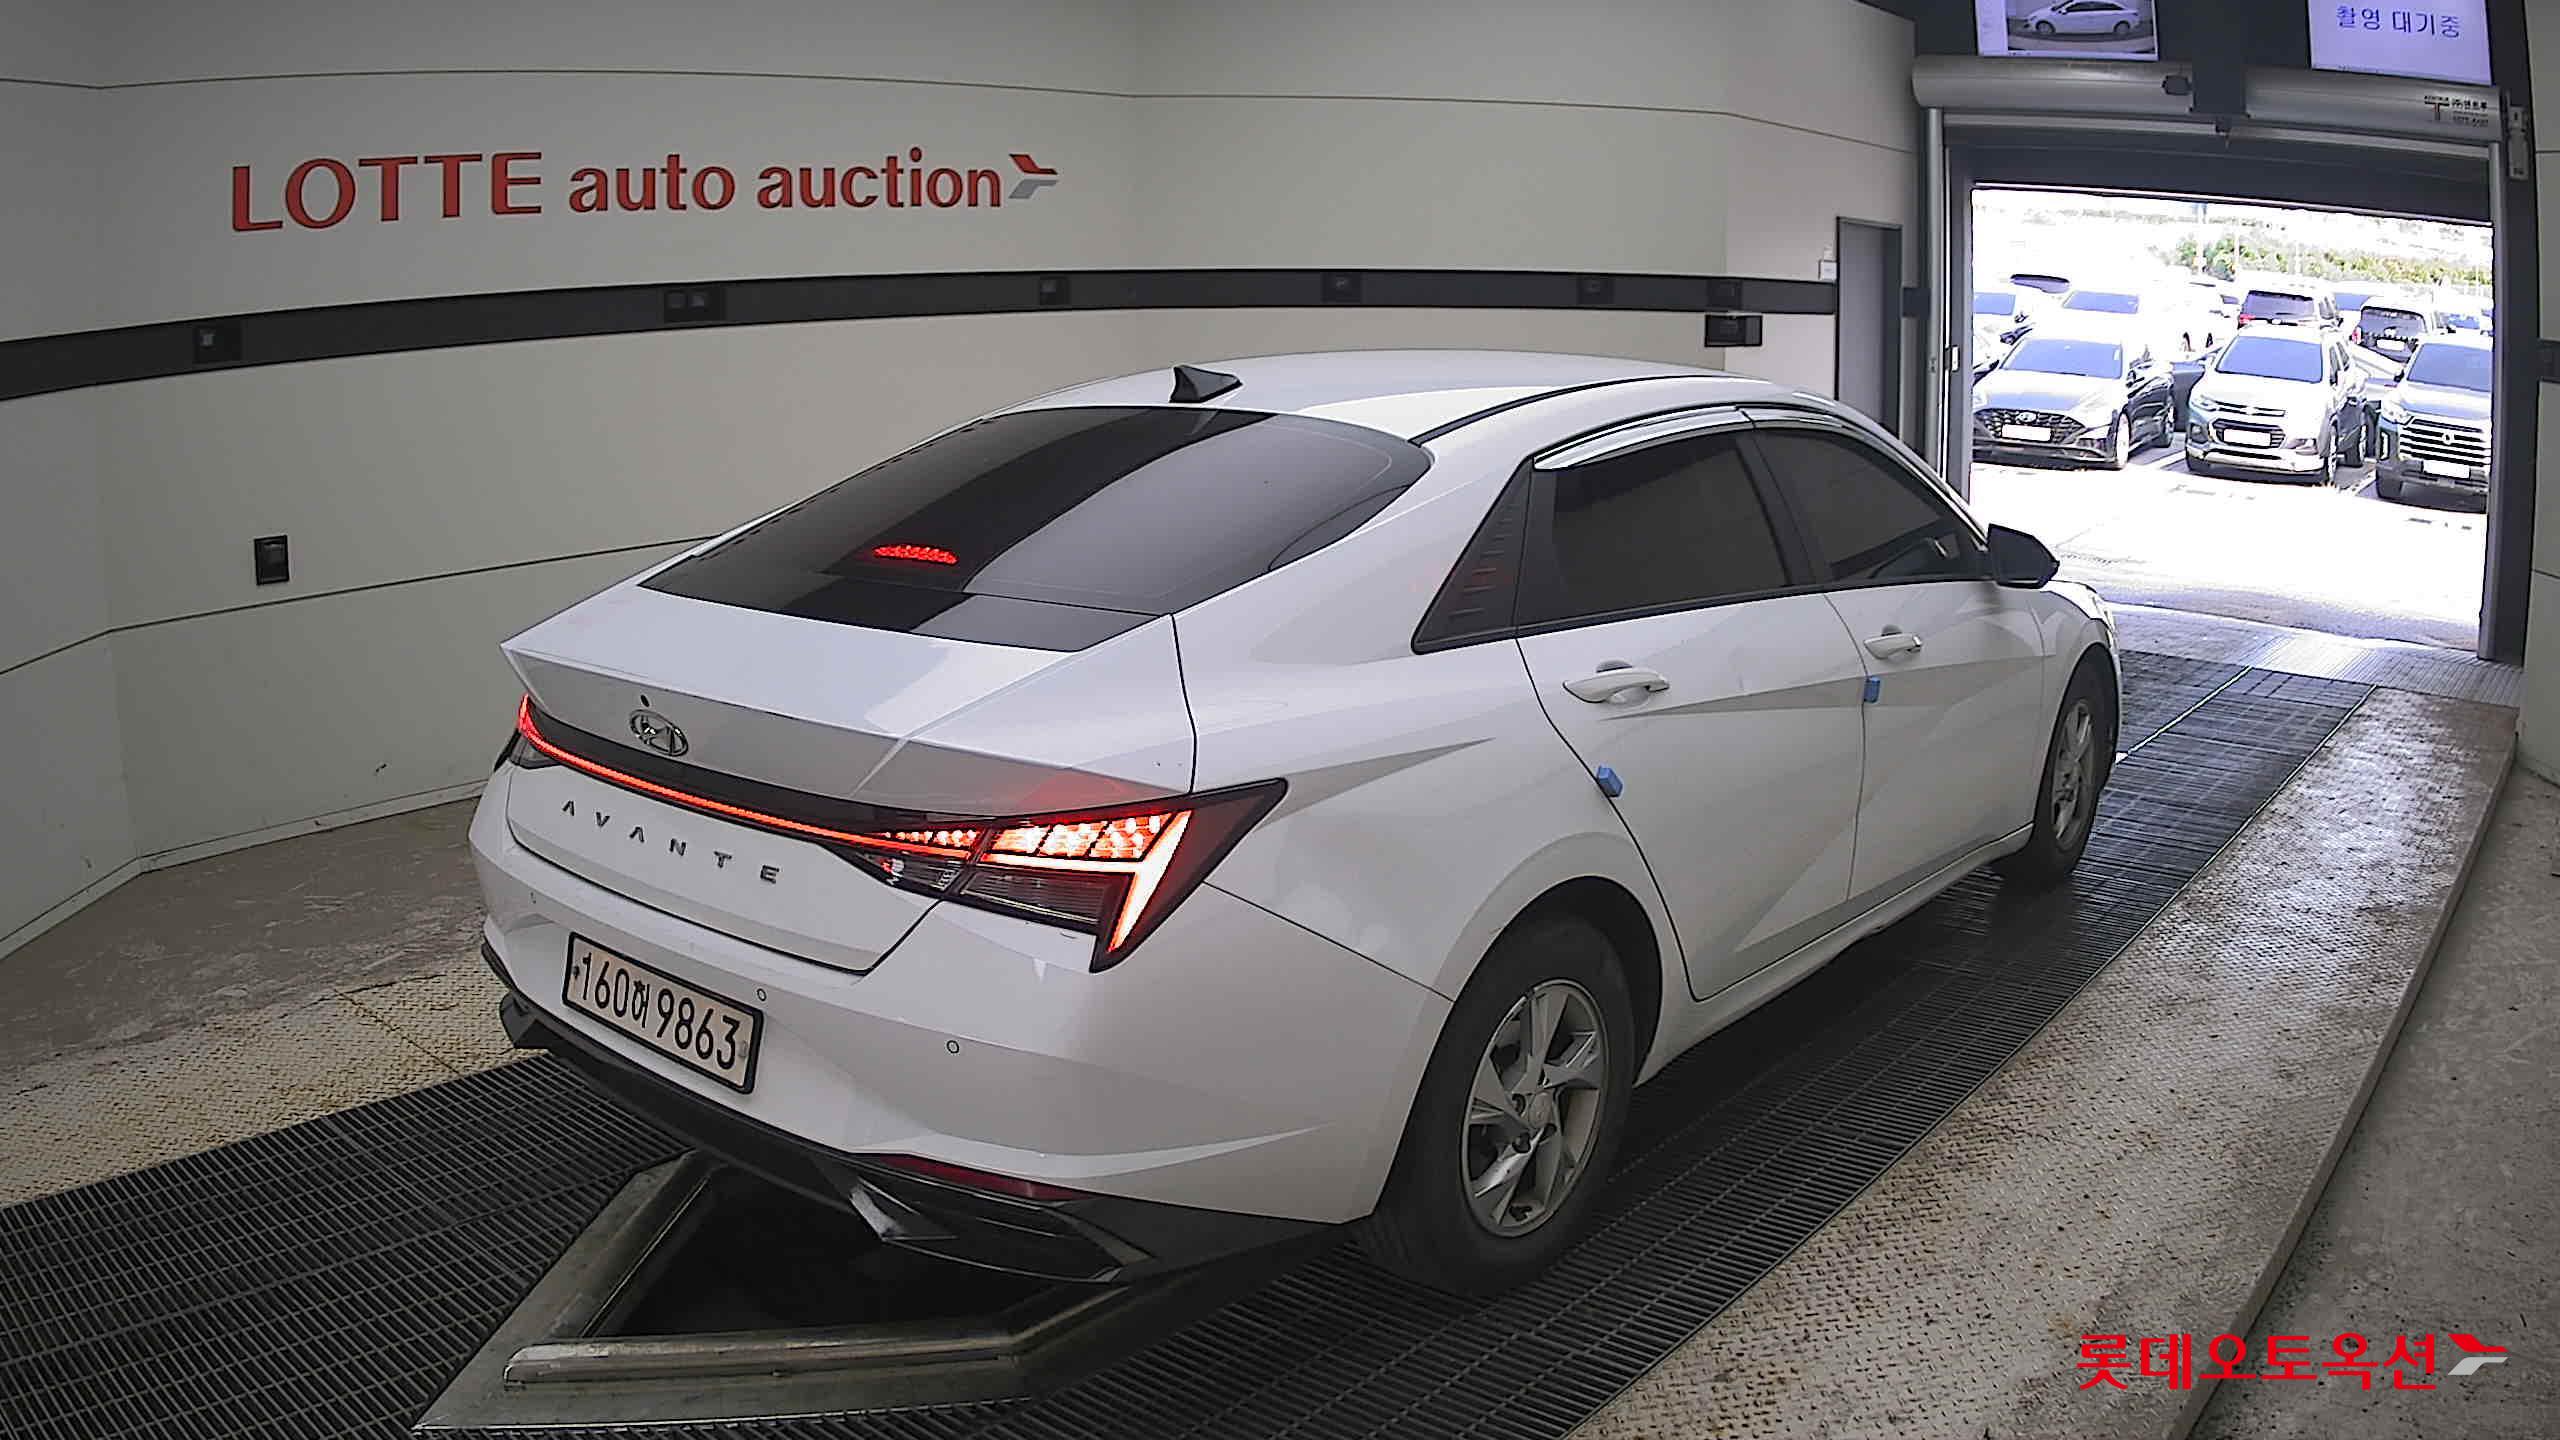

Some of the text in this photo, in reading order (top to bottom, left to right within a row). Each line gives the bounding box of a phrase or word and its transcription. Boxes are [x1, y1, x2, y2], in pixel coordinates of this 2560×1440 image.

[2336, 6, 2461, 38] 촬영 대기중
[232, 148, 1001, 232] LOTTE auto auction
[562, 799, 780, 884] AVANTE
